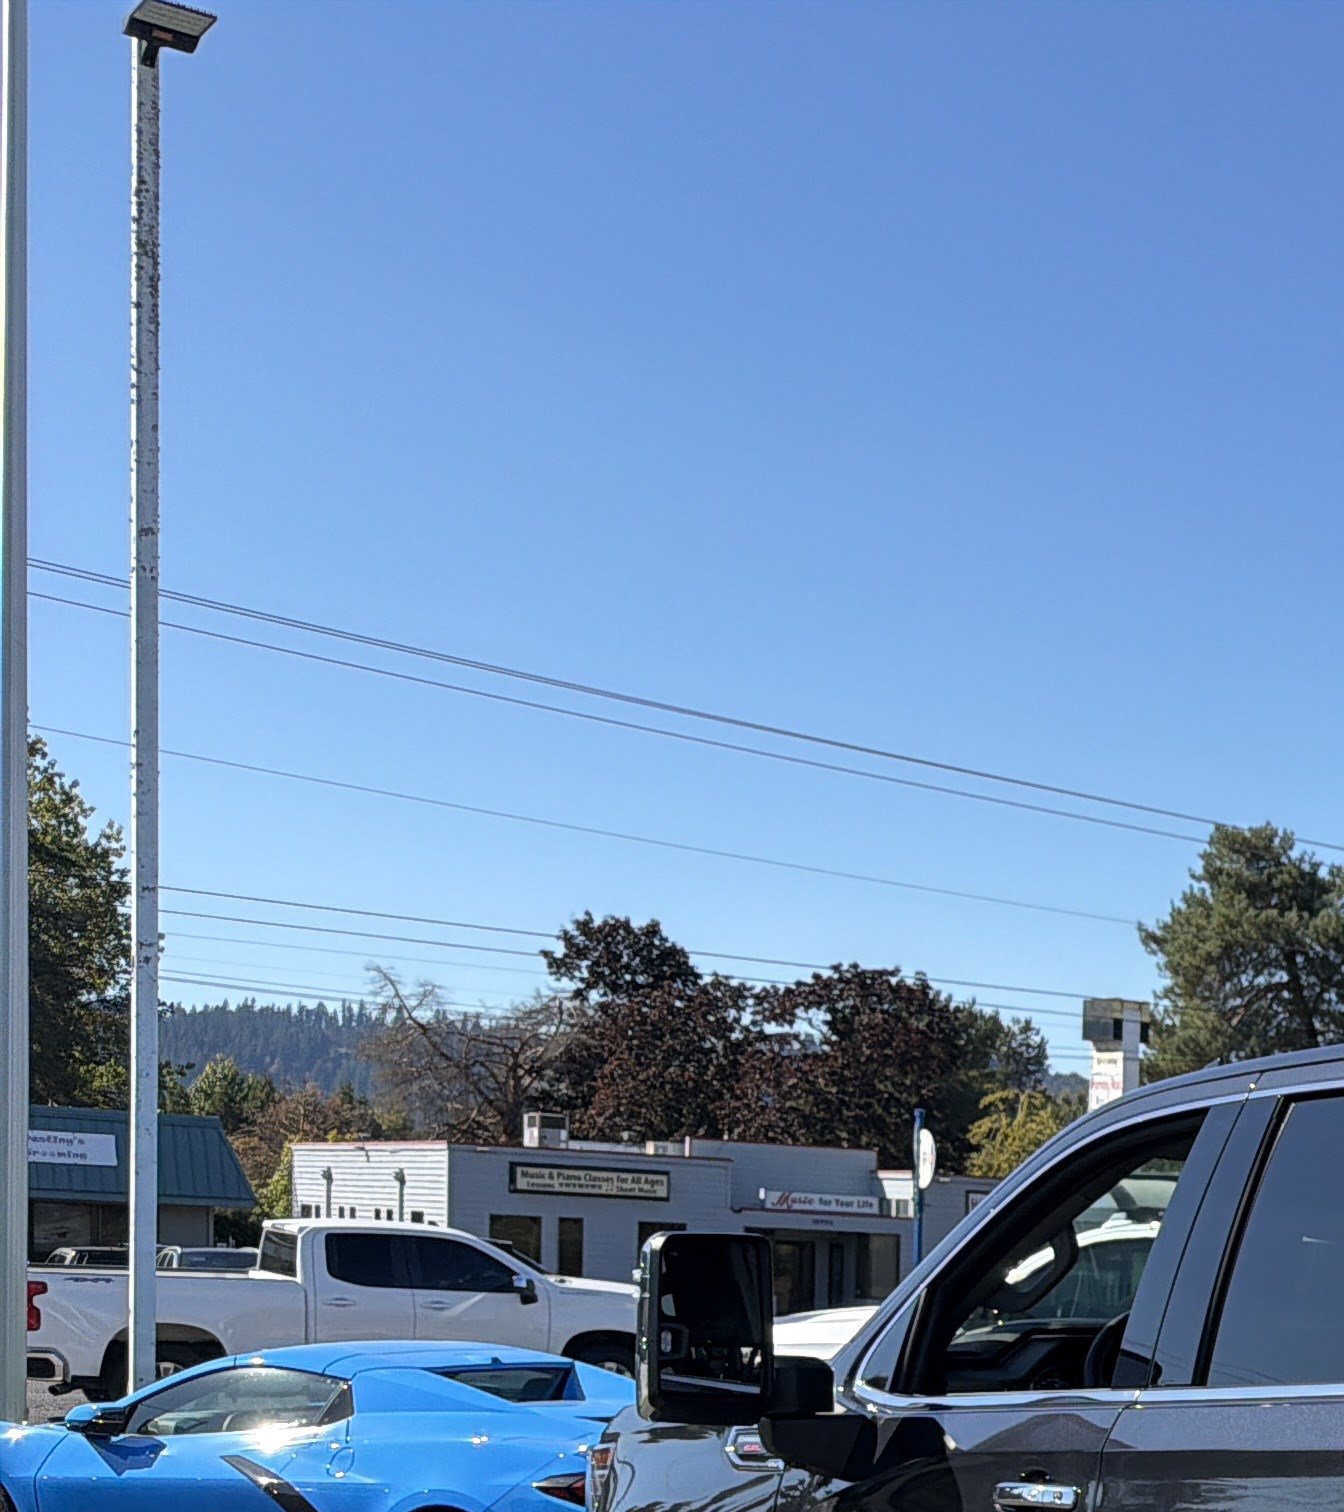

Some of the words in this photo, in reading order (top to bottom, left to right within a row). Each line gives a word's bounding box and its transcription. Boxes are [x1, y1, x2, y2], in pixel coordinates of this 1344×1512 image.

[520, 1169, 546, 1179] Music
[547, 1171, 555, 1180] &
[556, 1171, 582, 1182] Piano
[583, 1173, 615, 1184] Classes
[616, 1175, 629, 1184] for
[630, 1176, 643, 1185] All
[644, 1177, 665, 1189] Ages
[775, 1190, 814, 1210] Music
[818, 1196, 832, 1206] for
[835, 1198, 854, 1208] Your
[856, 1200, 874, 1209] Life
